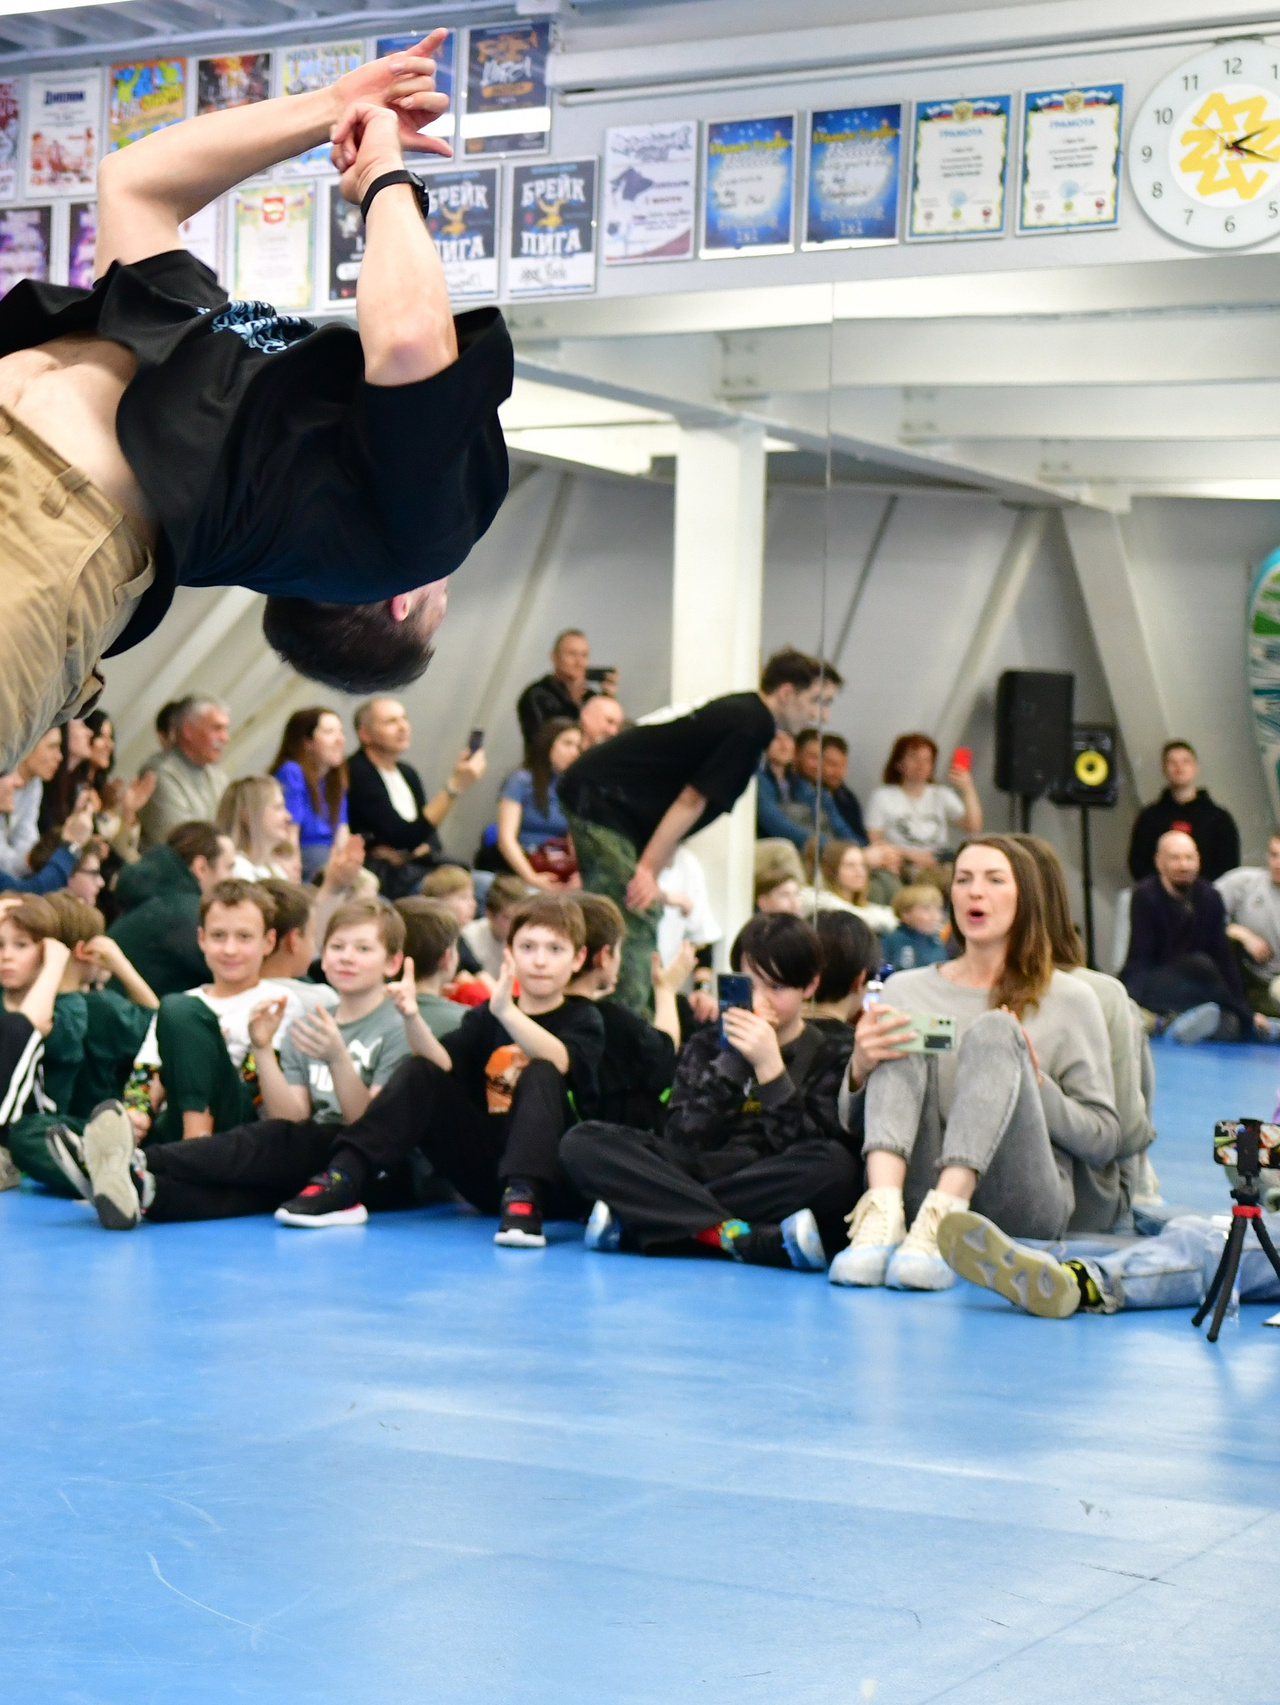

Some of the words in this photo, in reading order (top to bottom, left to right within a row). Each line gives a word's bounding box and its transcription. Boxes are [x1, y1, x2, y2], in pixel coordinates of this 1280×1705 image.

[1223, 57, 1243, 75] 12
[1271, 64, 1278, 79] 1
[1182, 74, 1199, 91] 11
[1154, 107, 1174, 125] 10
[1142, 145, 1153, 163] 9
[521, 173, 586, 207] БРЕЙК
[1152, 182, 1163, 199] 8
[1183, 209, 1195, 226] 7
[1268, 201, 1278, 218] 5
[1225, 215, 1236, 233] 6
